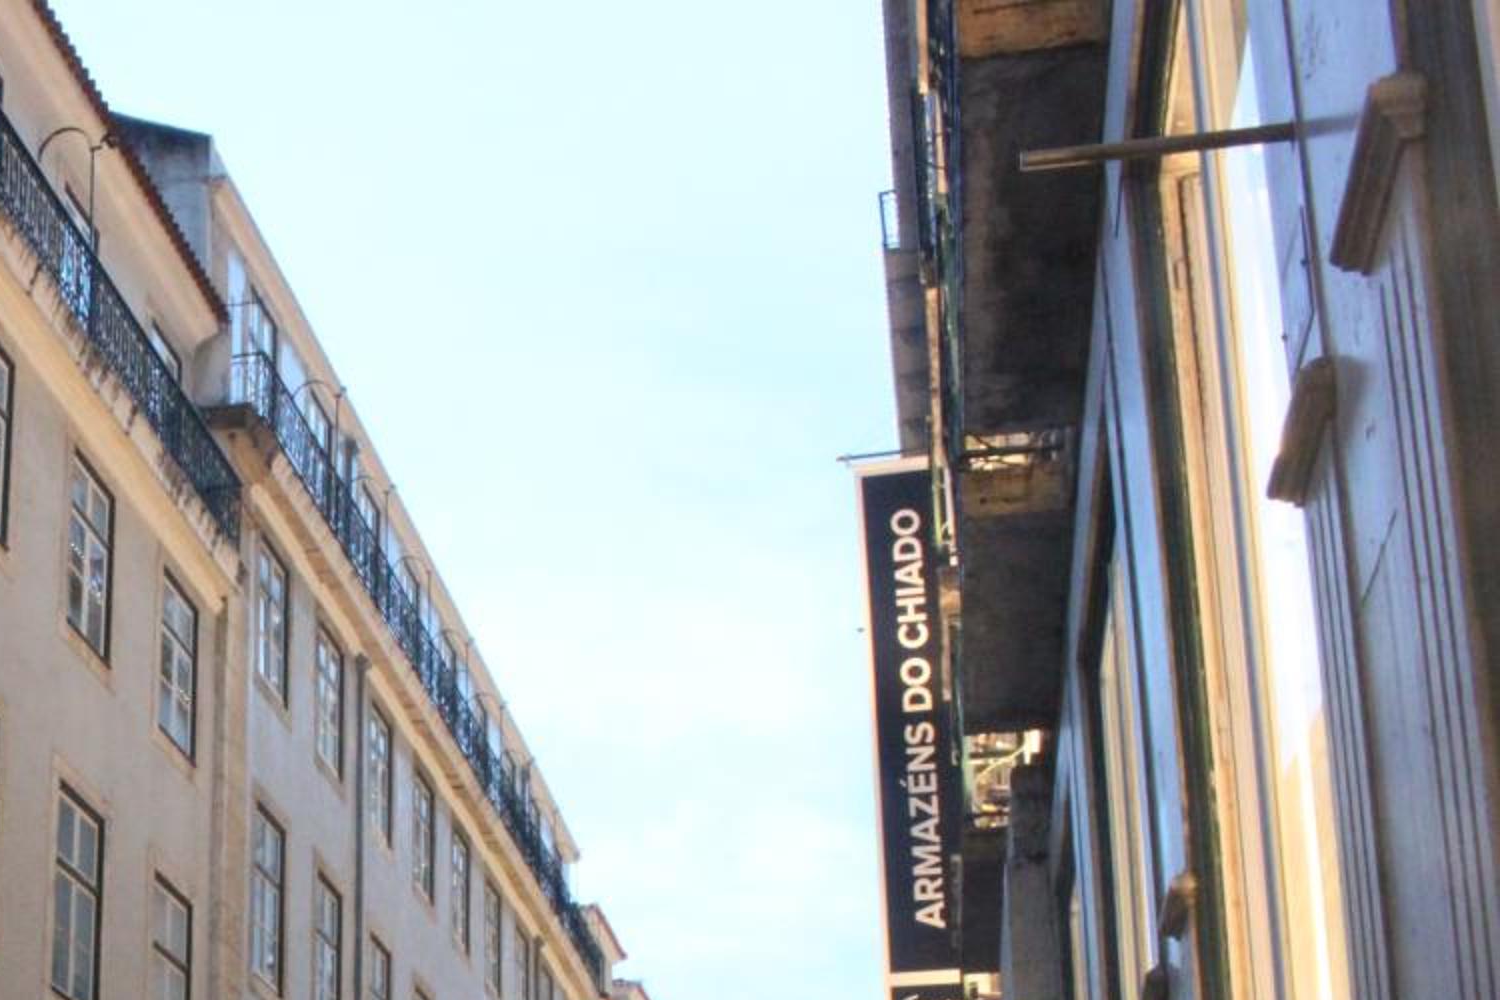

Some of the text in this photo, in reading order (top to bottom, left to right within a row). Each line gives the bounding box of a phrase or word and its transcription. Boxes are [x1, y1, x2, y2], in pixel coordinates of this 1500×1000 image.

[890, 508, 947, 929] ARMAZÉNS DO CHIADO
